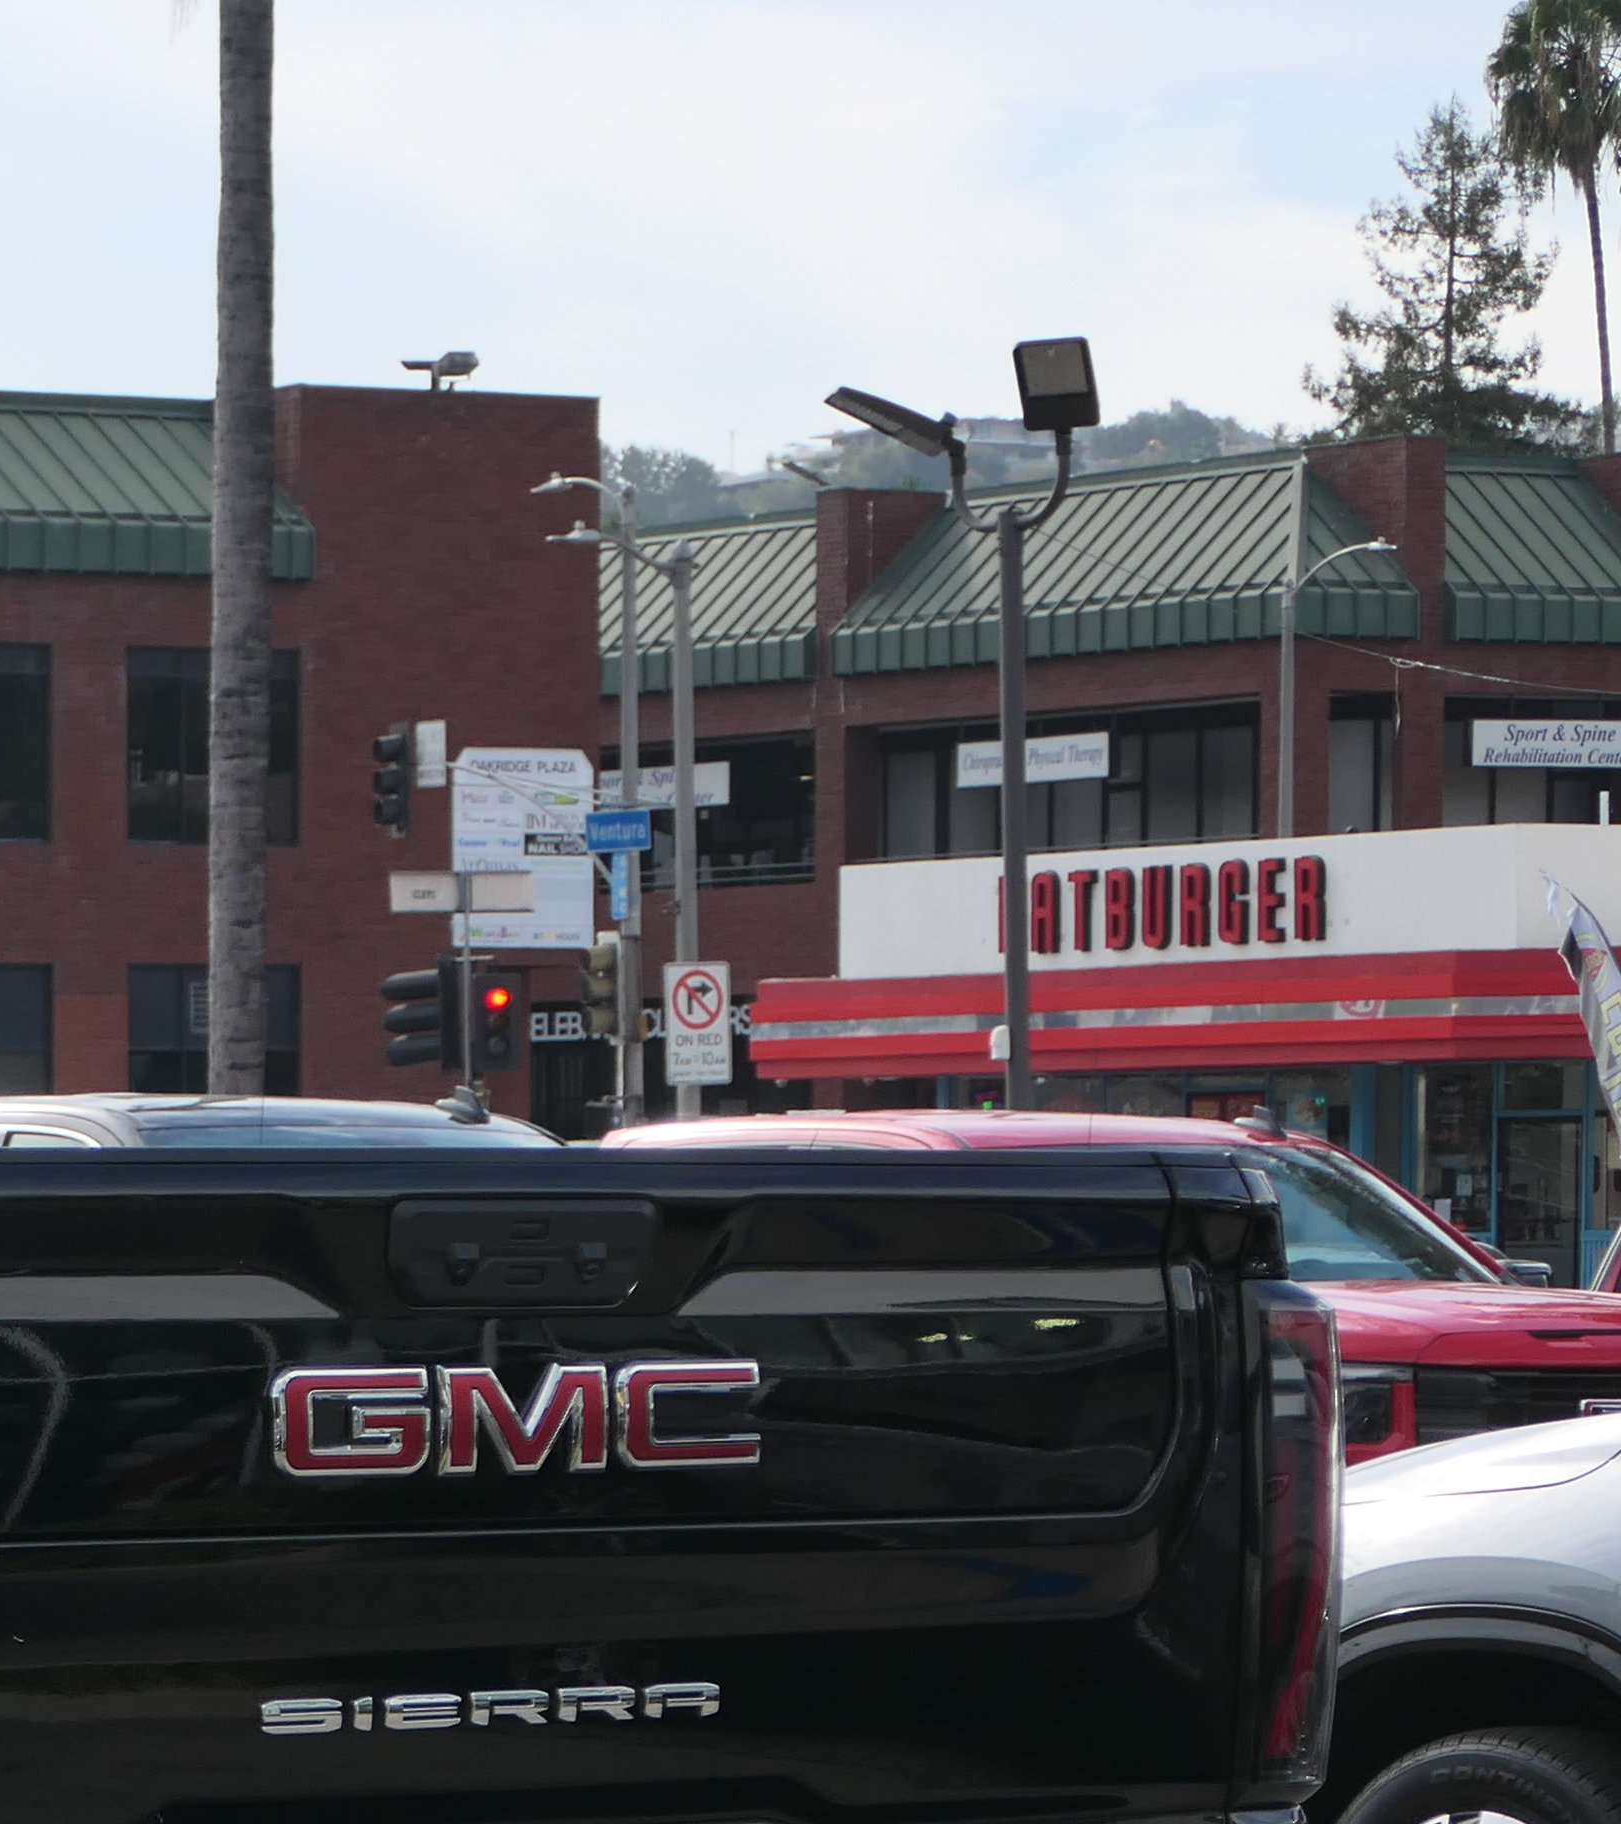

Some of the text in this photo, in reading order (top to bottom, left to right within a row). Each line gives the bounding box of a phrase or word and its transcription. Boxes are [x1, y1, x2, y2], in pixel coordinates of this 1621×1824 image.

[1504, 723, 1617, 747] Sport & Spine
[470, 759, 577, 773] OAKRIDGE PLAZA
[1483, 747, 1621, 764] Rehabilitation Cent
[590, 822, 647, 842] Ventura
[998, 855, 1328, 954] ATBURGER
[675, 1032, 723, 1047] ON RED
[271, 1358, 762, 1478] GMC
[260, 1682, 721, 1735] SIERRA
